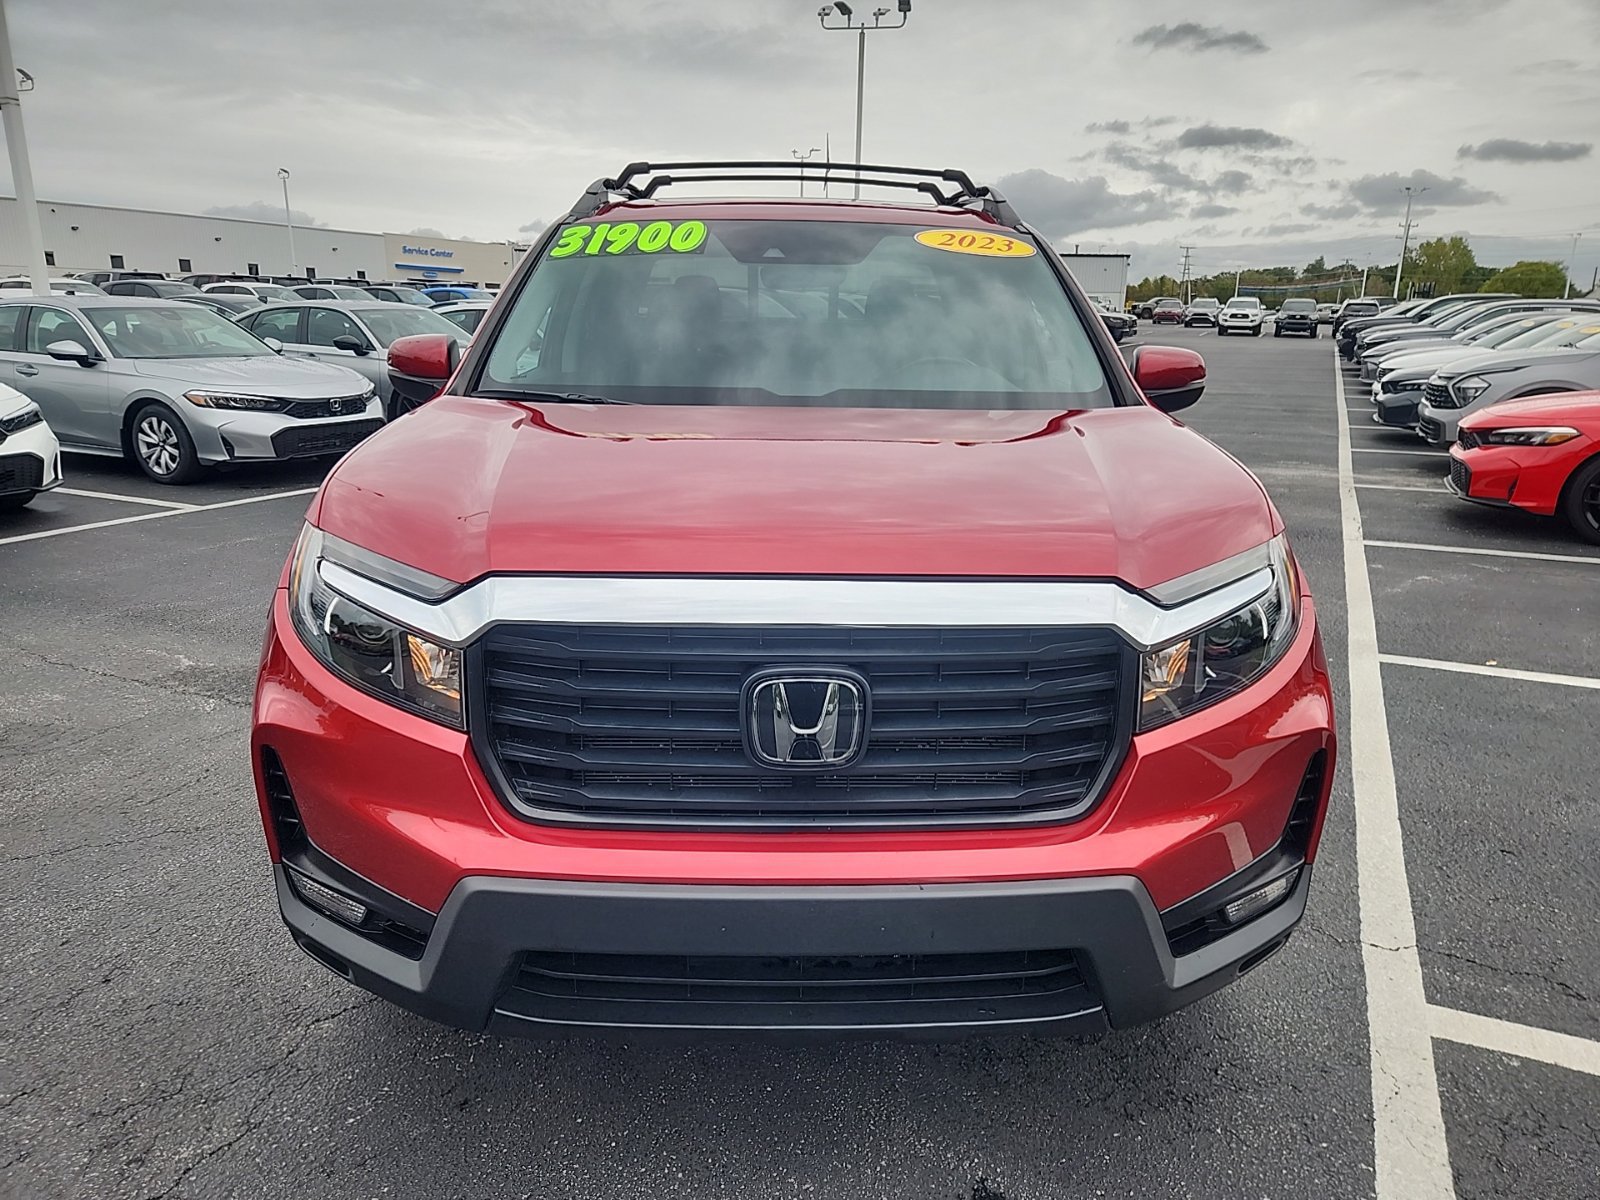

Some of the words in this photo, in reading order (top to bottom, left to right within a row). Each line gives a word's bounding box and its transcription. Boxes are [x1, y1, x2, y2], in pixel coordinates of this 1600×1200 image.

[549, 220, 708, 258] 31900
[937, 233, 1015, 252] 2023
[402, 245, 429, 256] Service
[429, 248, 454, 258] Center
